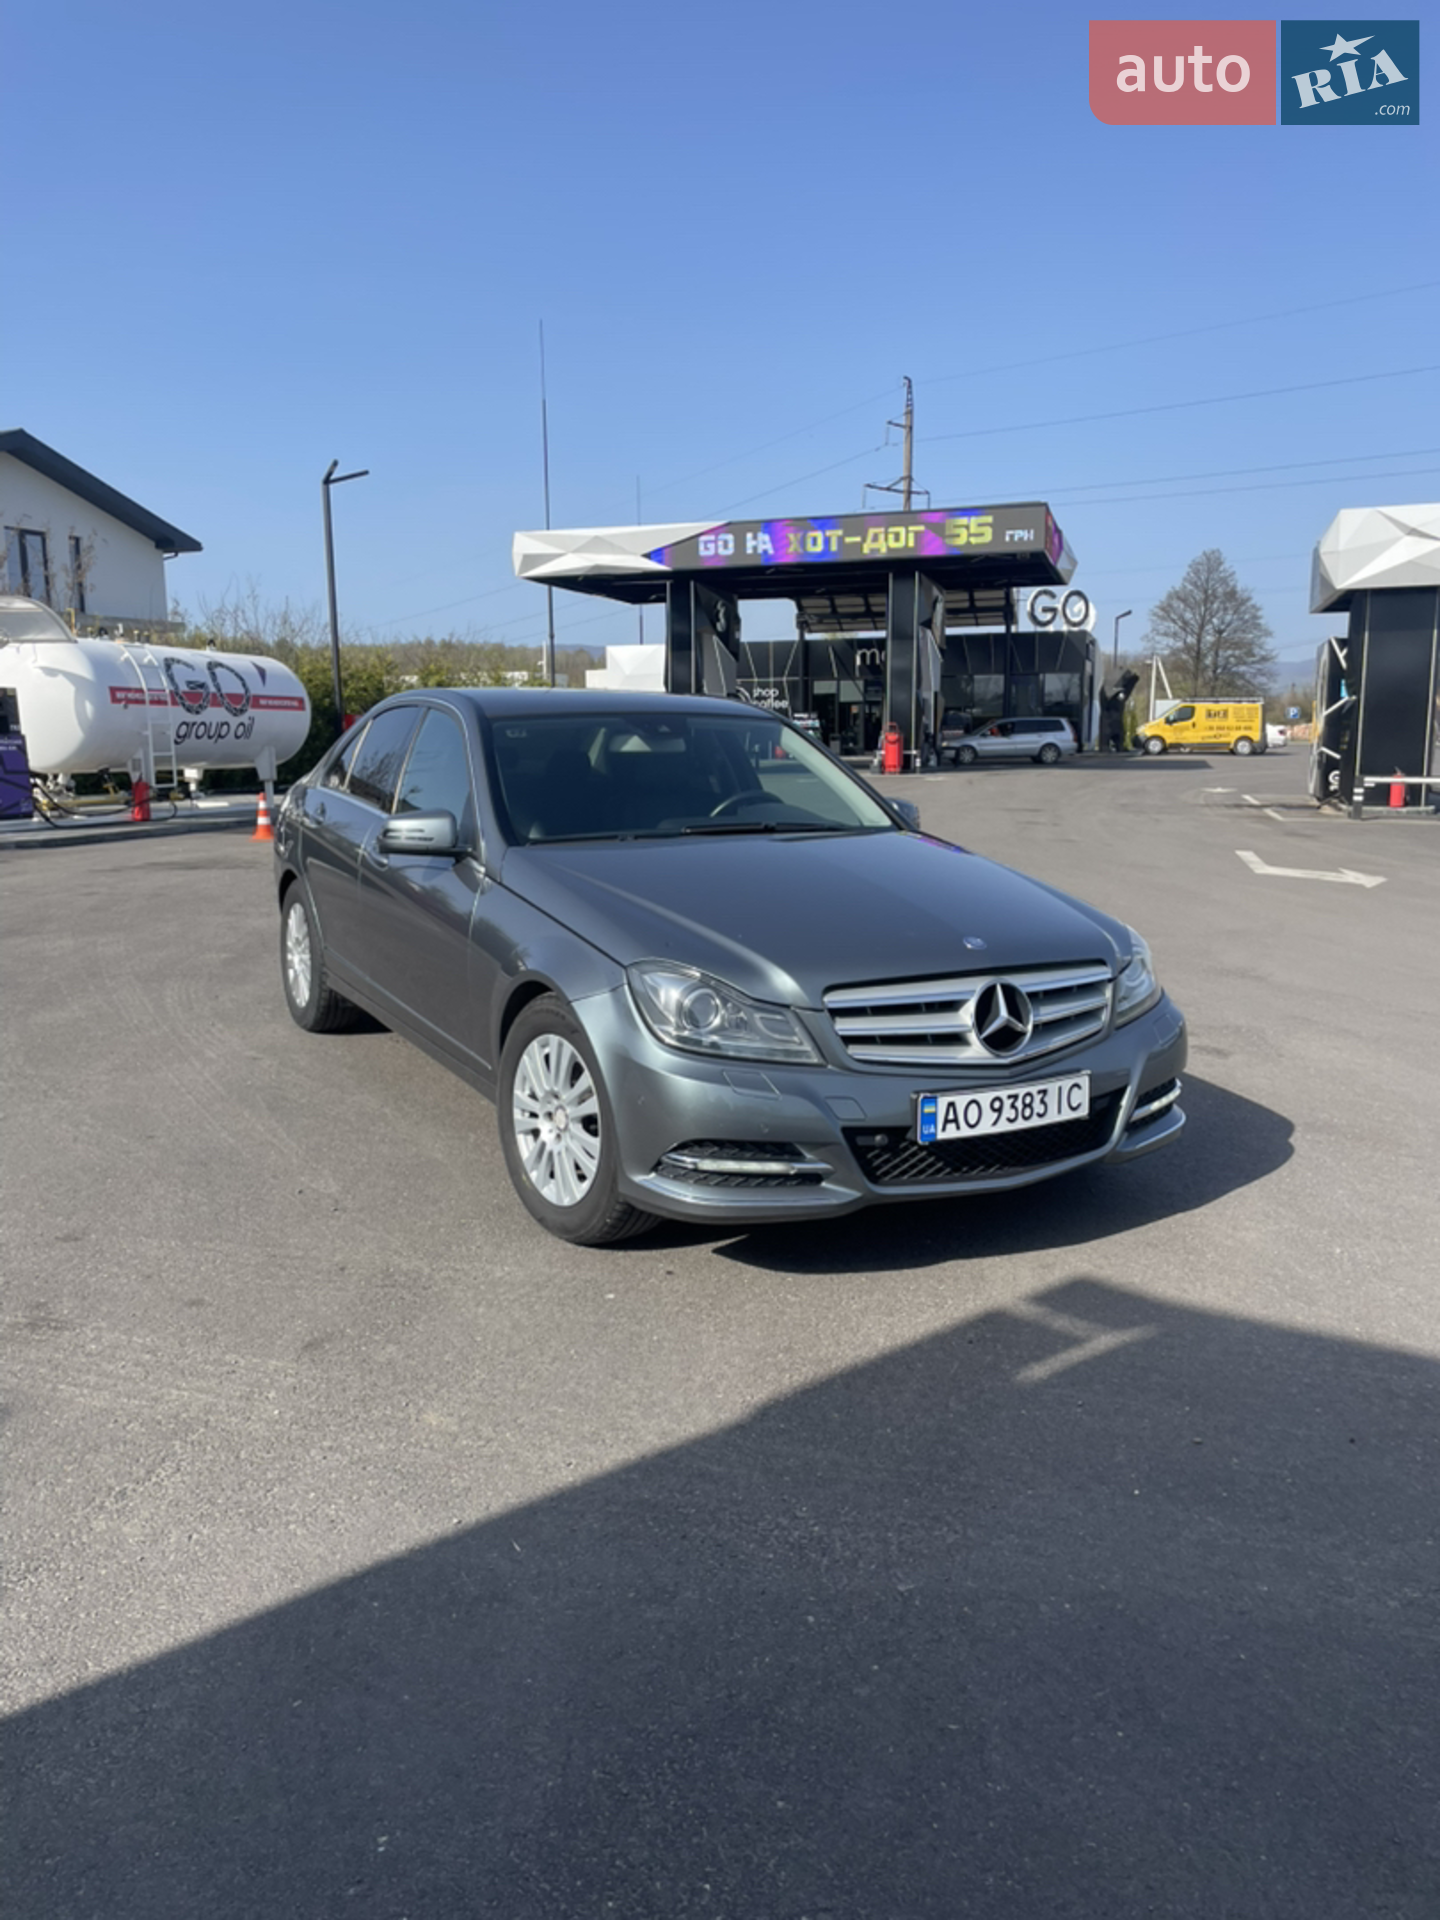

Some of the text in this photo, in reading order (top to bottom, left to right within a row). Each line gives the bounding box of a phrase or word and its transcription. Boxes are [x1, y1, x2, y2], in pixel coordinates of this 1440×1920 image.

[698, 533, 735, 556] GO
[746, 532, 775, 555] НА
[945, 515, 994, 546] 55
[1005, 529, 1034, 542] ГРН
[1027, 588, 1091, 628] GO
[163, 656, 251, 718] GO
[753, 687, 779, 701] shop
[174, 716, 255, 745] group oil
[941, 1082, 1082, 1132] AO 9383 IC
